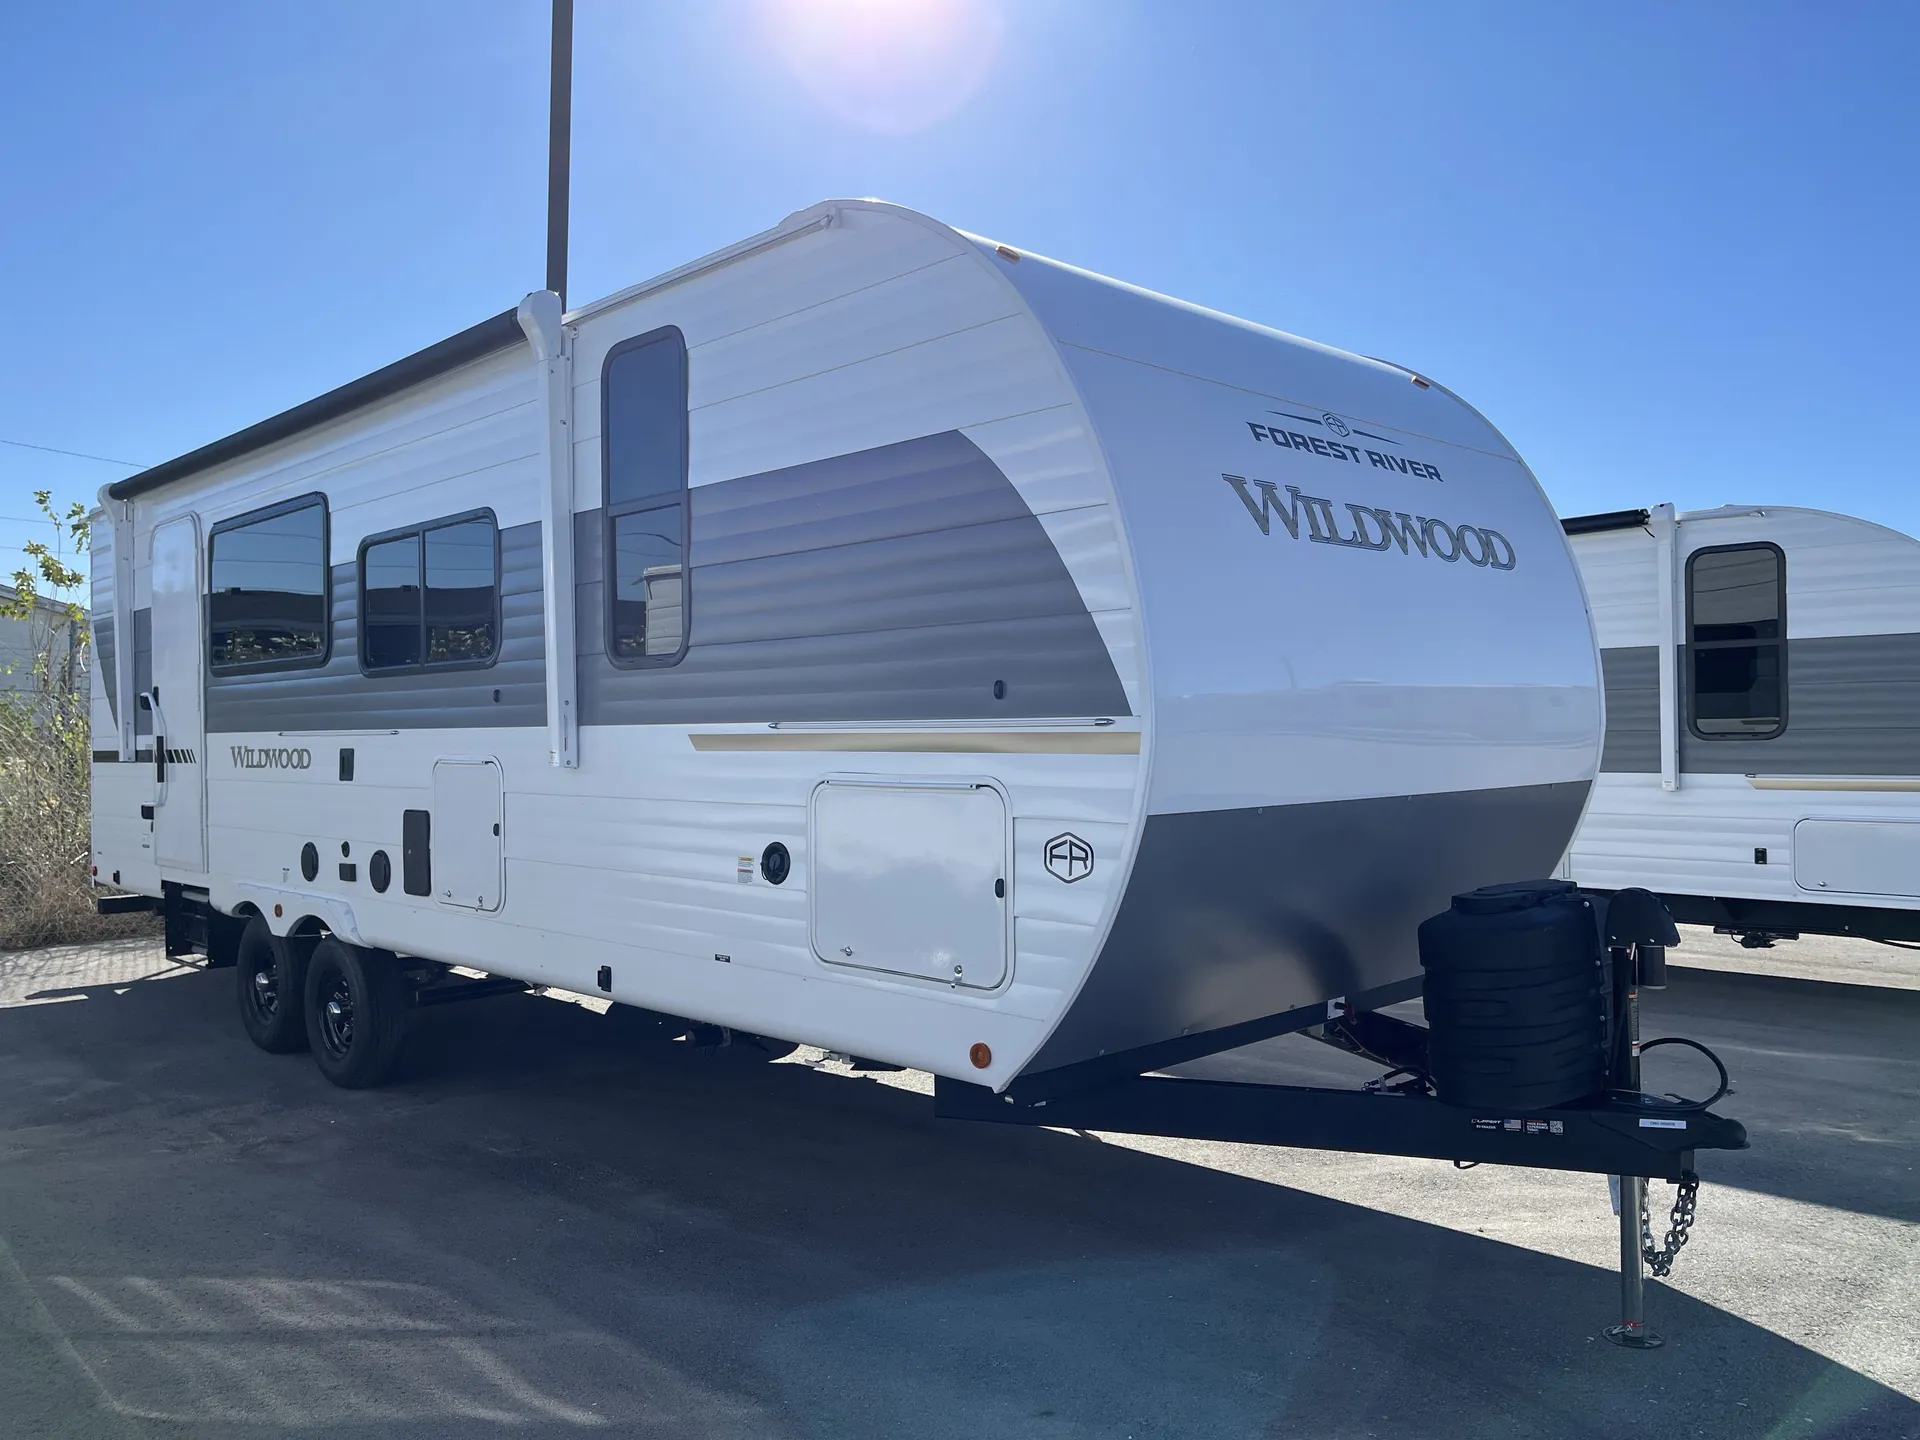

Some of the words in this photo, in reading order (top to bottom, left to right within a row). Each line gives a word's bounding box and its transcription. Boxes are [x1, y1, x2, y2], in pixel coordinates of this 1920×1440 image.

[1246, 421, 1361, 464] FOREST
[1363, 449, 1444, 483] RIVER
[1221, 473, 1517, 571] WILDWOOD
[230, 745, 312, 770] WILDWOOD
